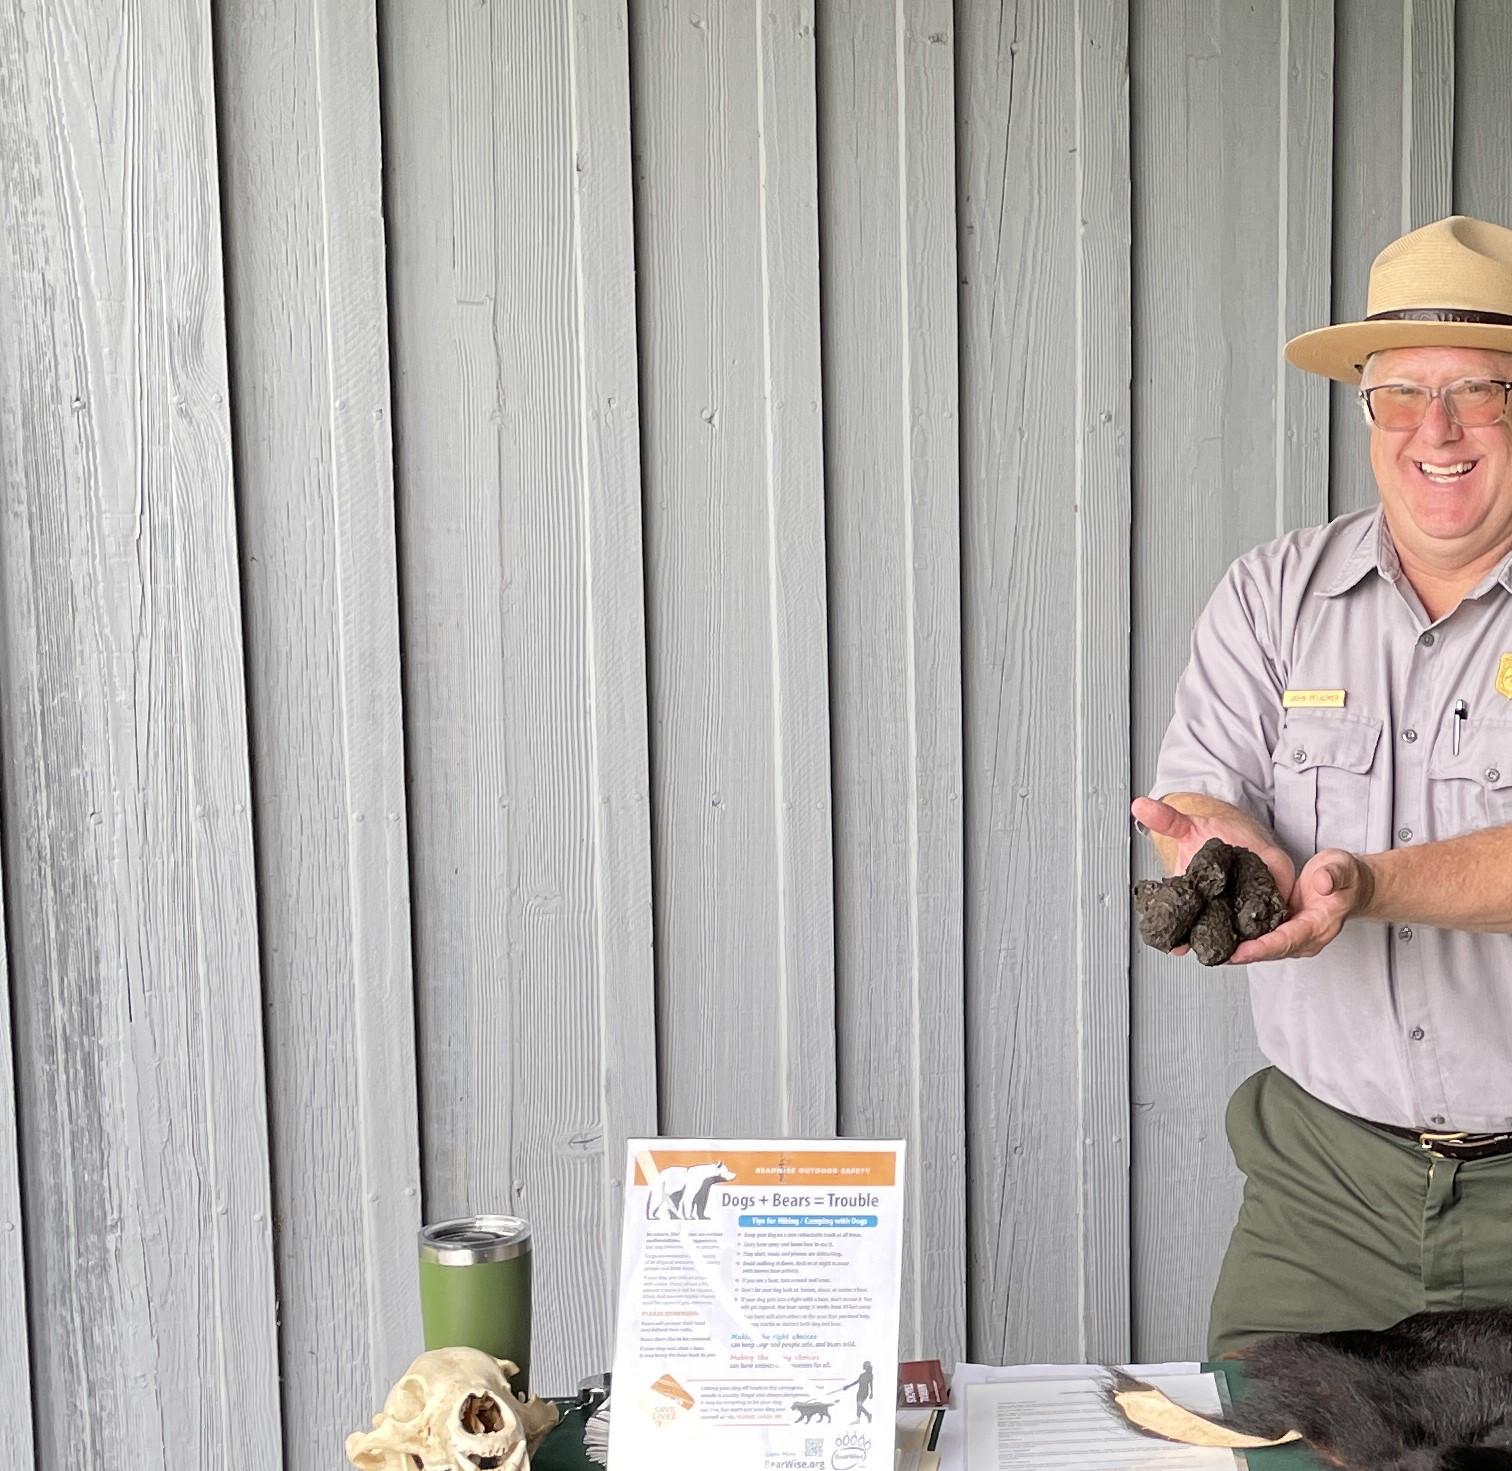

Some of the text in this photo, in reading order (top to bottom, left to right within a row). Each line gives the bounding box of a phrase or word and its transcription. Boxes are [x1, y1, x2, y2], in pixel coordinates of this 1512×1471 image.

[798, 1167, 838, 1175] OUTDOOR
[840, 1167, 871, 1175] SAFETY
[722, 1192, 880, 1210] Dogs + Bears = Trouble
[751, 1217, 767, 1226] Tips
[767, 1217, 777, 1225] for
[834, 1217, 851, 1225] with
[851, 1217, 868, 1226] Dogs
